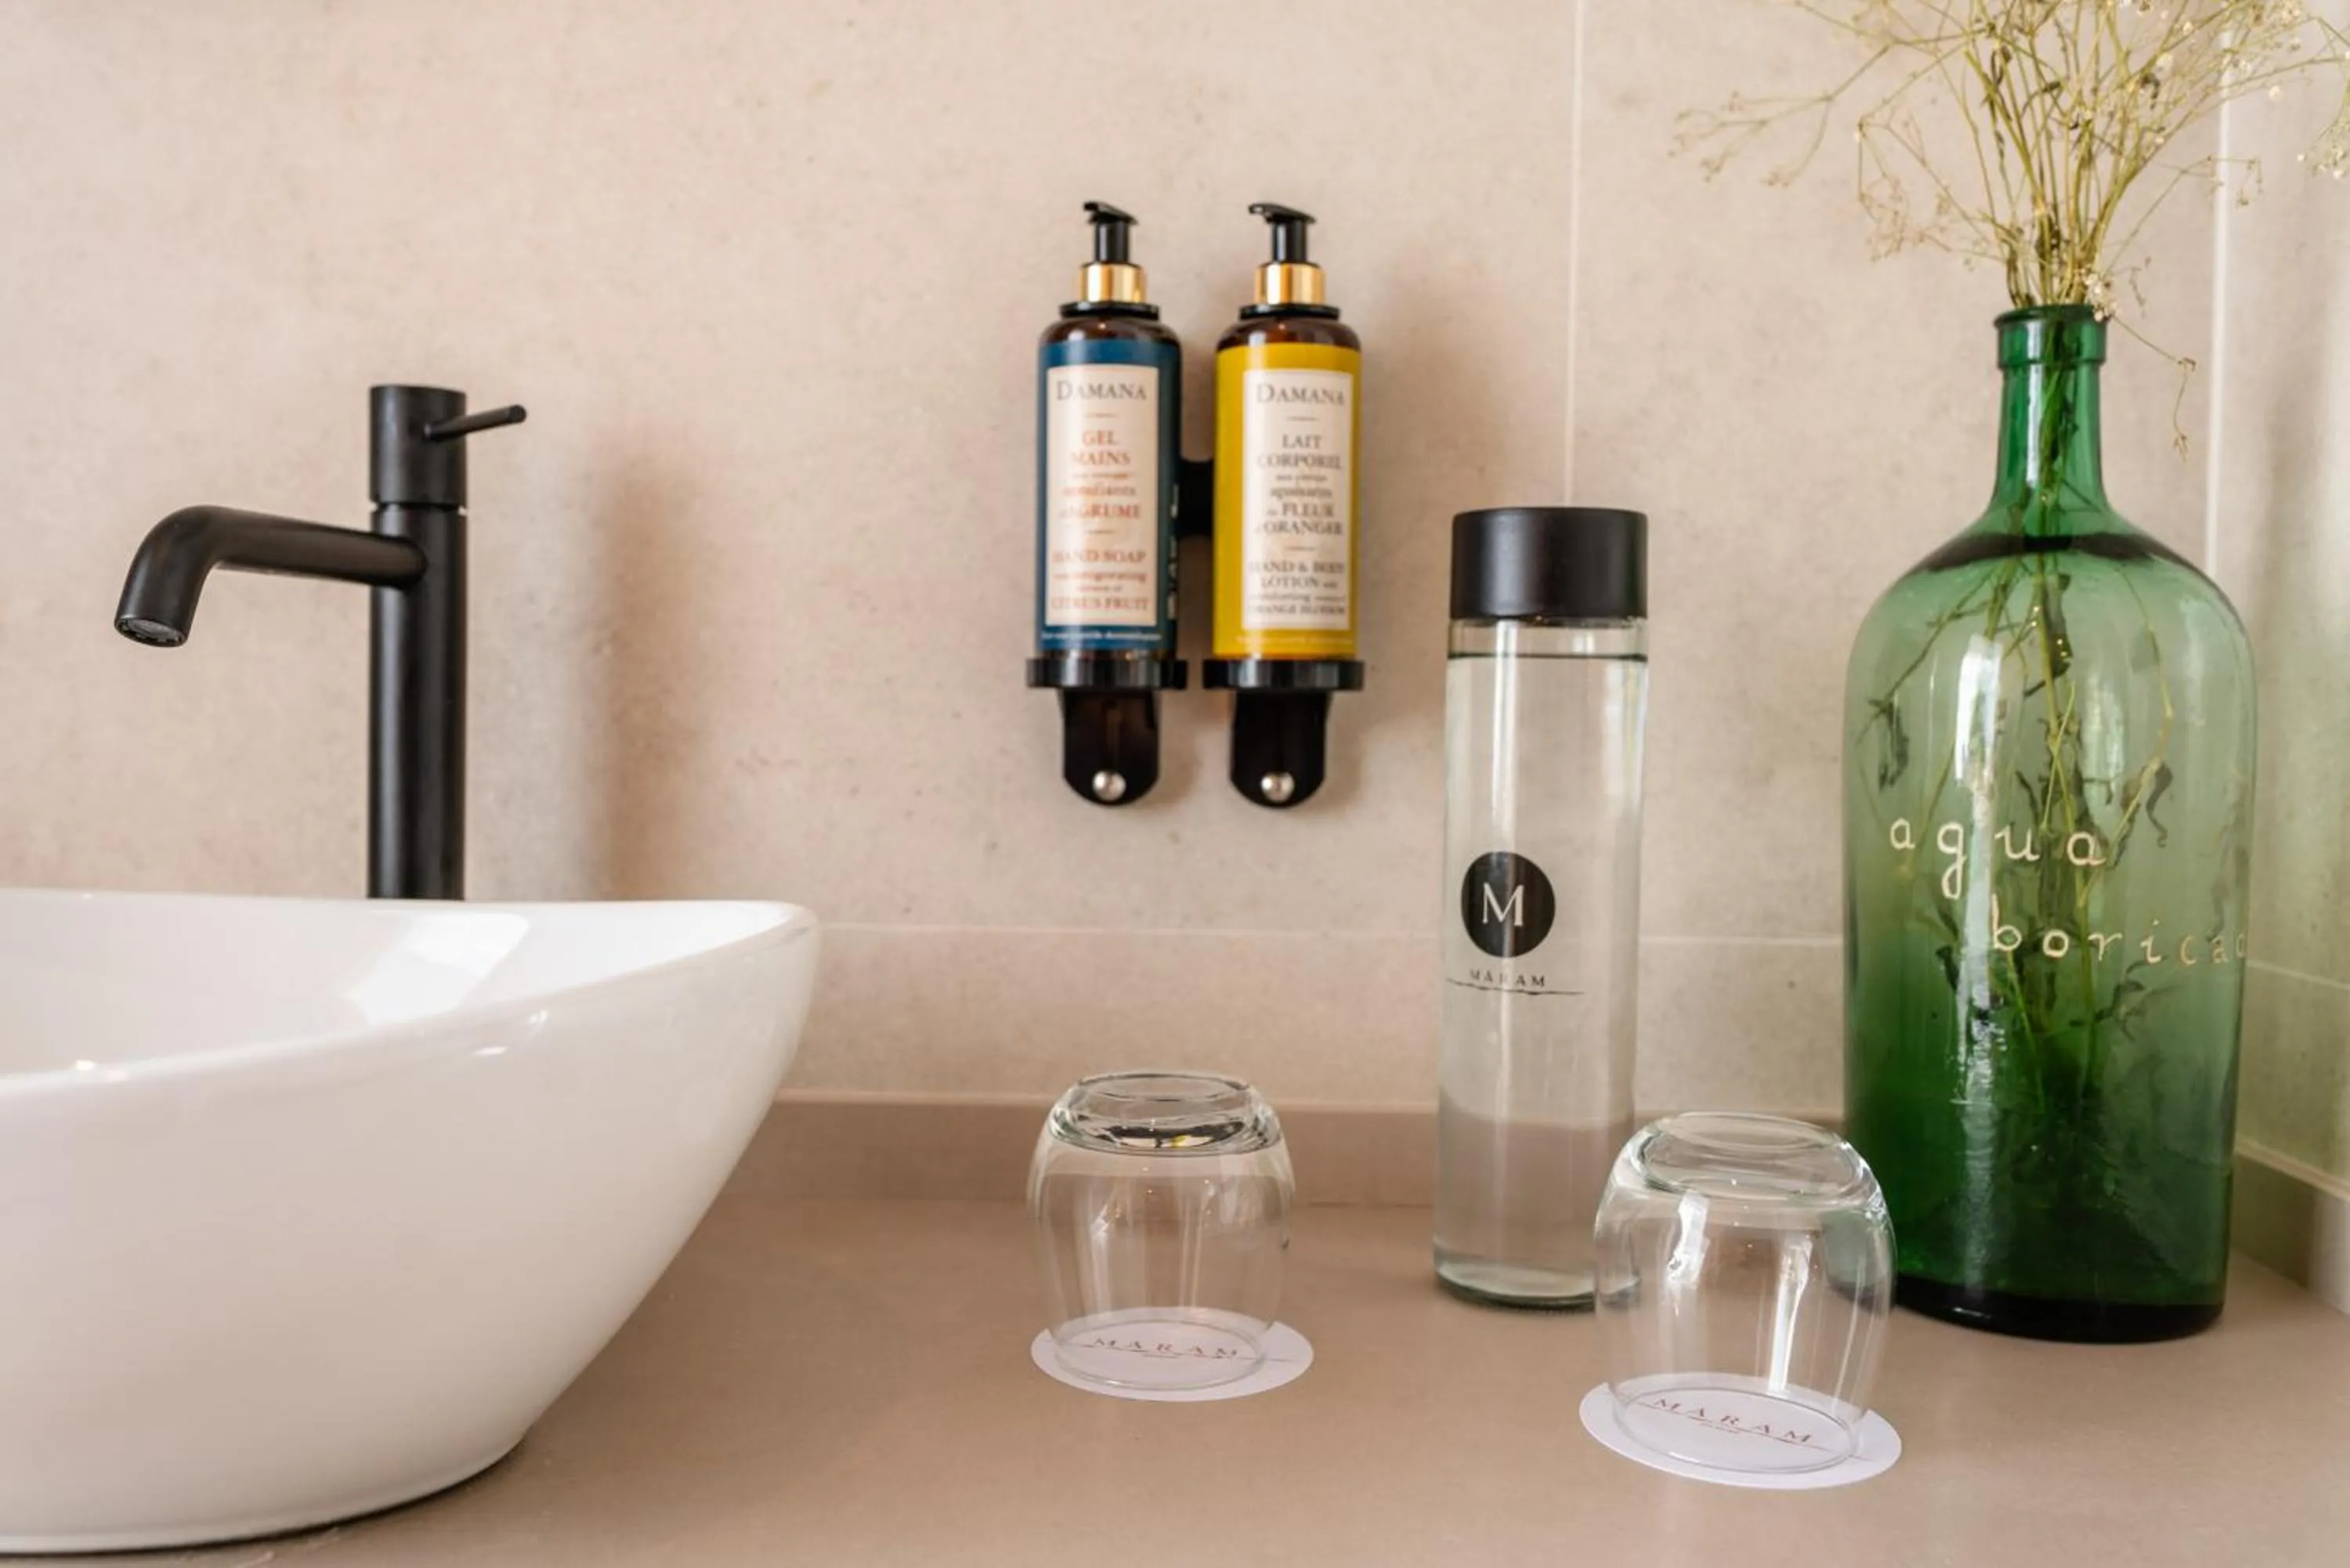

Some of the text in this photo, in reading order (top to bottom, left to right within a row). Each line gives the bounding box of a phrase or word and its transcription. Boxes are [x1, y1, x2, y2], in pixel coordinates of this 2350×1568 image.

[1056, 381, 1148, 400] DAMANA
[1256, 383, 1345, 405] DAMANA
[1082, 430, 1119, 446] GEL
[1282, 434, 1322, 449] LAIT
[1889, 817, 2110, 900] agua
[1481, 882, 1525, 927] M
[1652, 1398, 1813, 1443] MARAM
